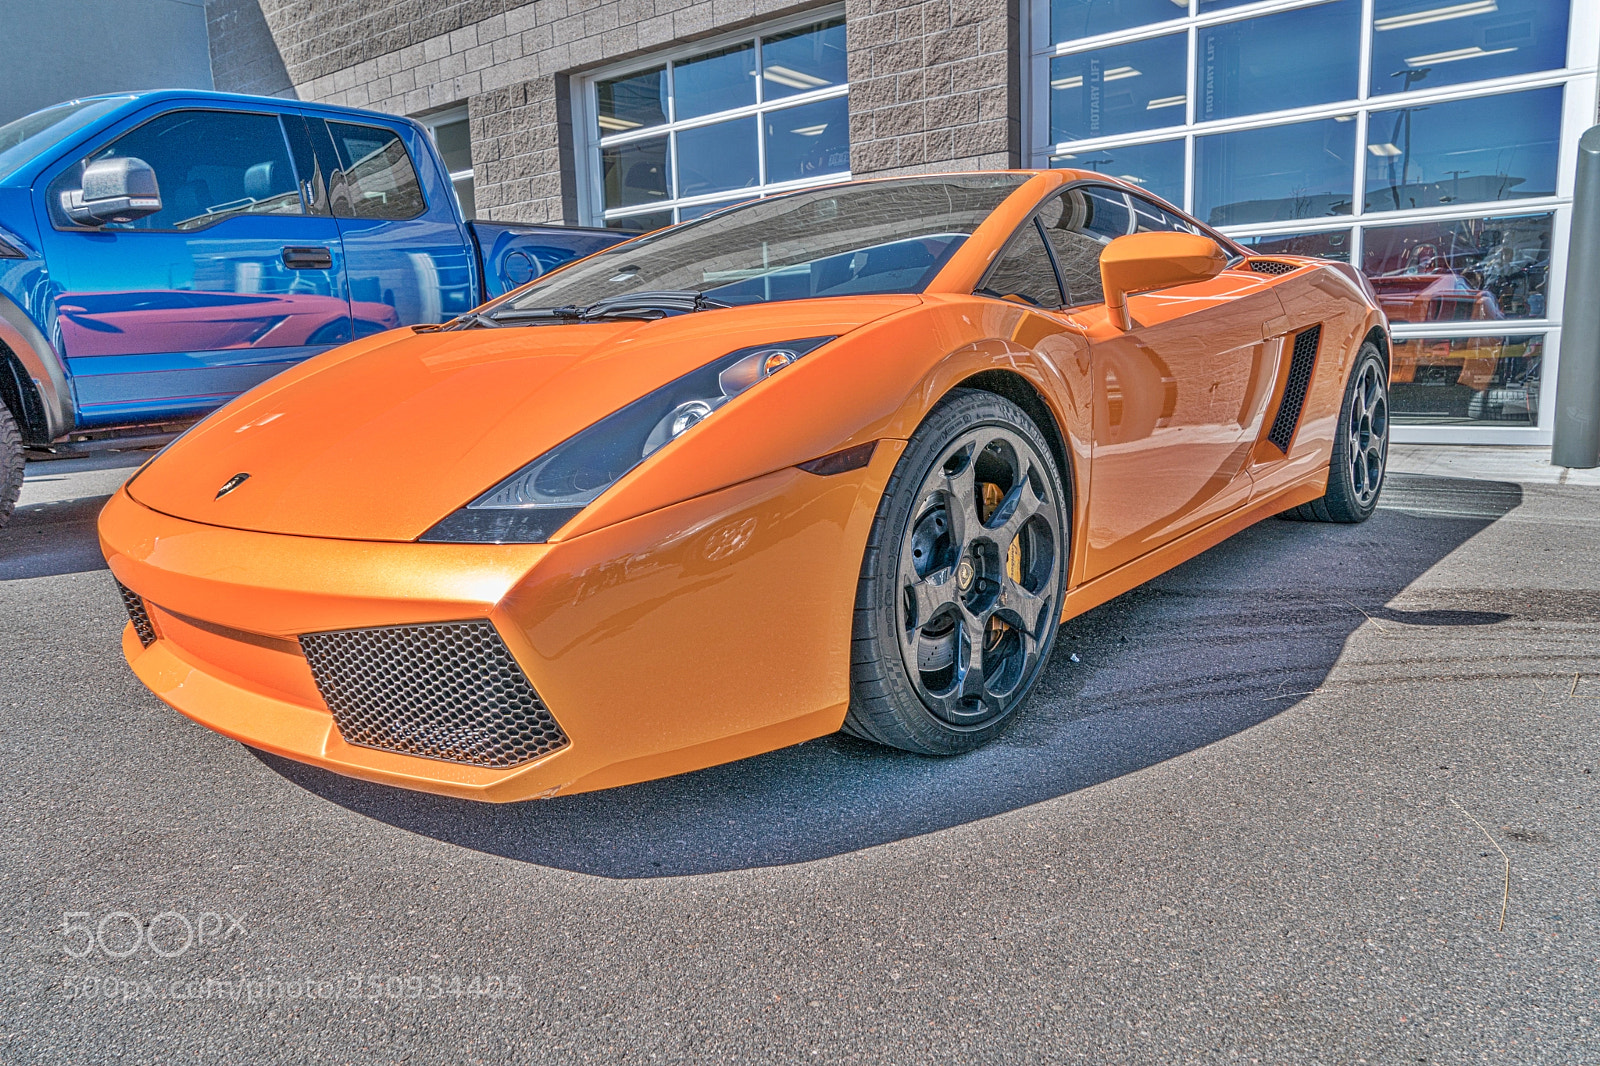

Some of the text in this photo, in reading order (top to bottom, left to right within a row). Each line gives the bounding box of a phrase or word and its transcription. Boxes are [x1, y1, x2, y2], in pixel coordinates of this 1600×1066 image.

[1090, 58, 1100, 130] ROTARY LIFT
[1206, 36, 1215, 113] ROTARY LIFT
